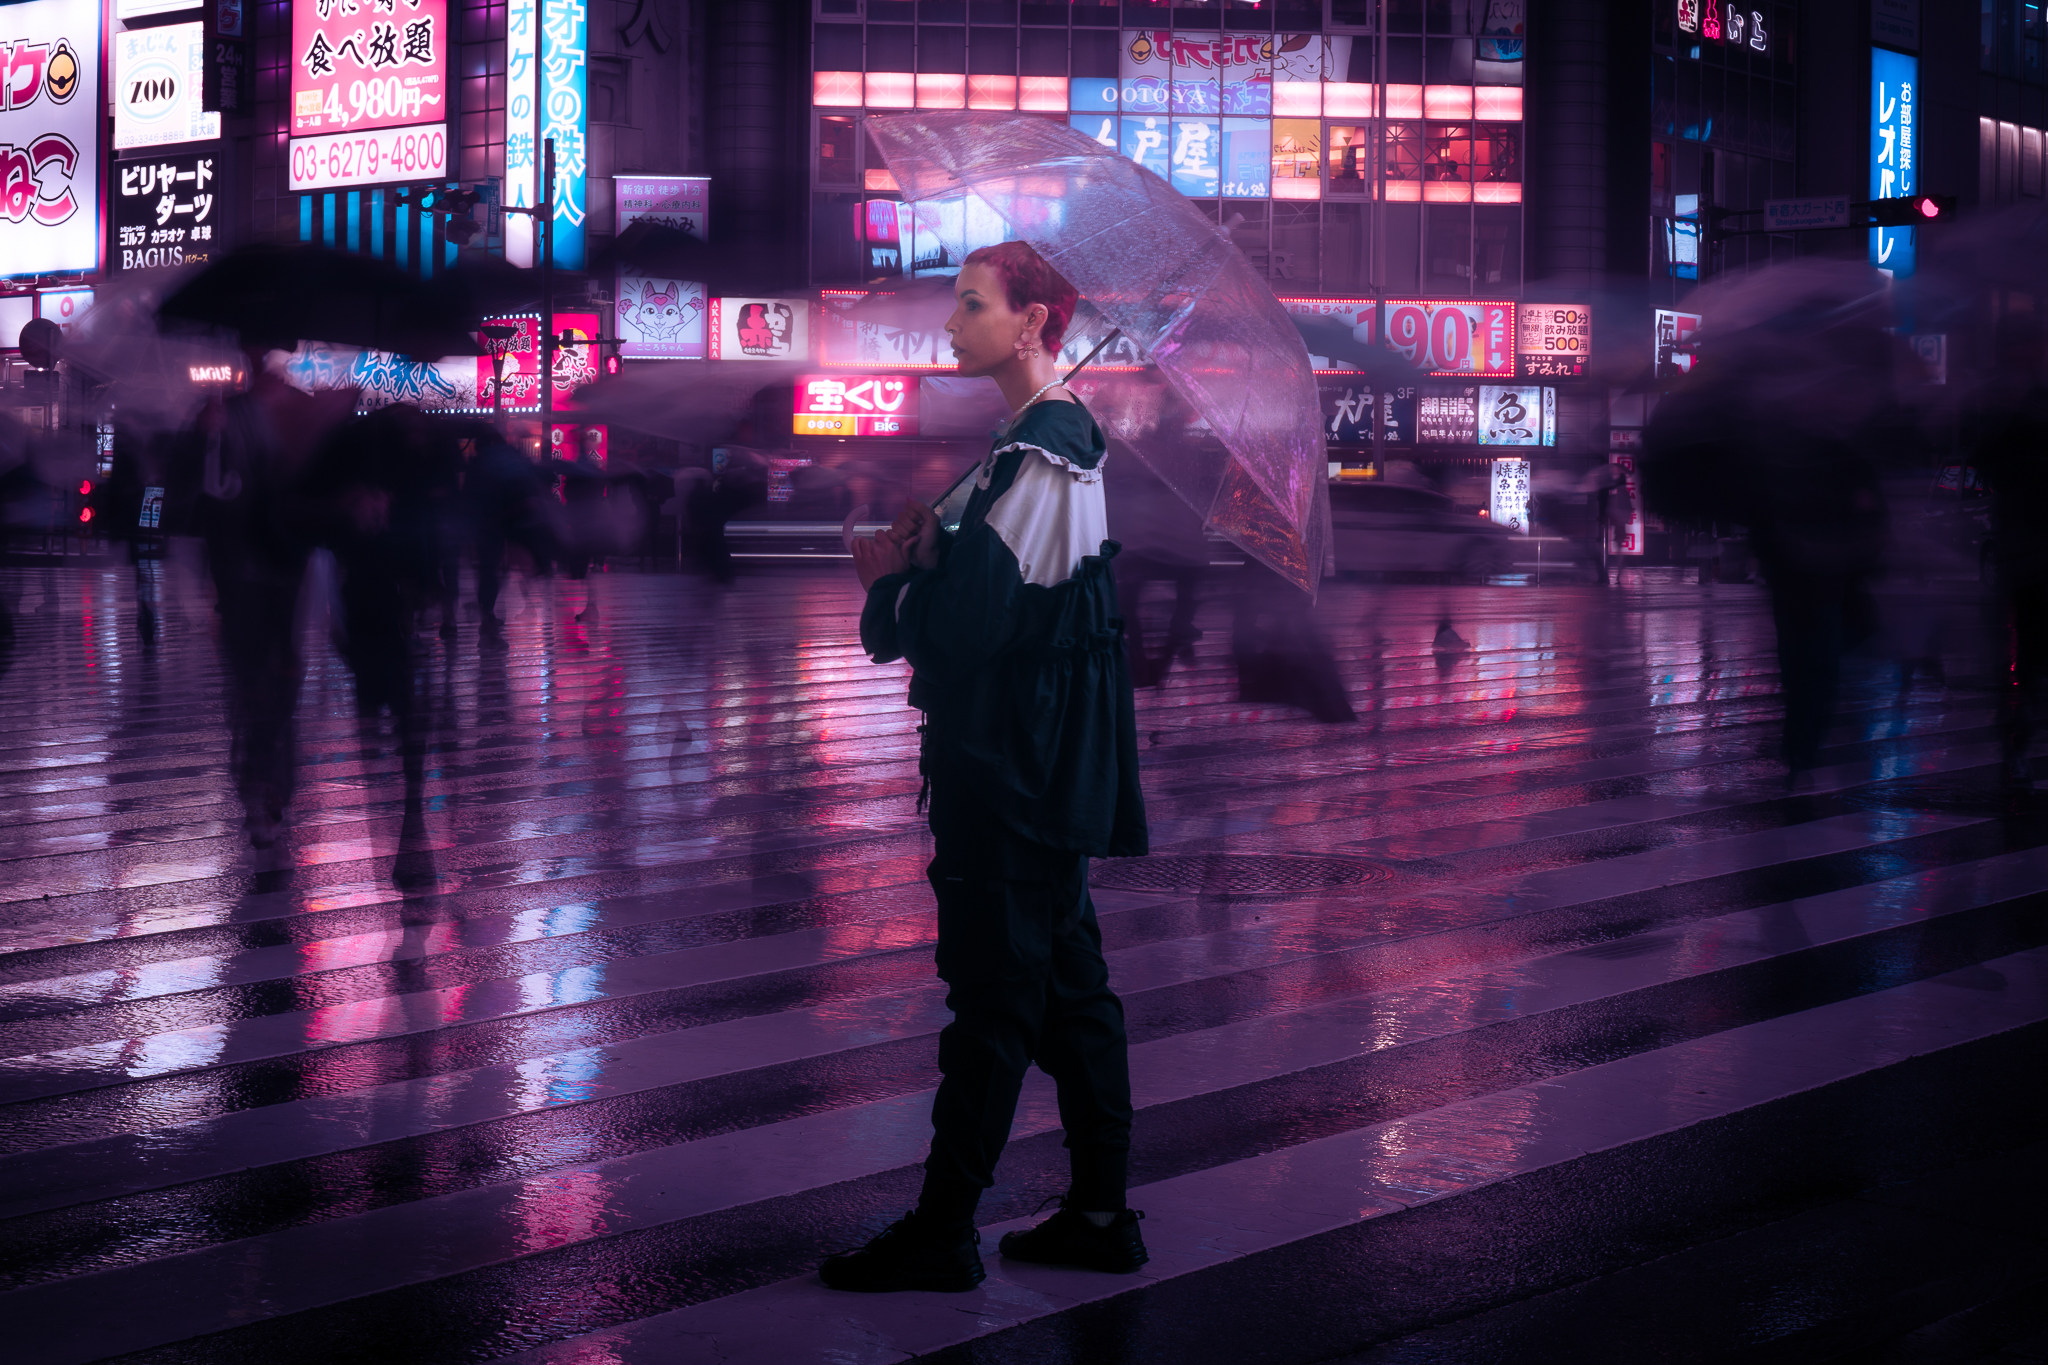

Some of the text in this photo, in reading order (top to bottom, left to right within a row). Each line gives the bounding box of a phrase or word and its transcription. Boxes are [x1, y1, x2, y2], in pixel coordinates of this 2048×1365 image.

[216, 43, 242, 66] 24H
[305, 18, 433, 76] 食べ放題
[0, 42, 50, 110] ケ
[130, 77, 175, 104] ZOO
[1102, 87, 1206, 105] OOTOYA
[1900, 82, 1911, 199] お部屋探し
[293, 131, 444, 182] 03-6279-4800
[121, 158, 213, 196] ビリヤード
[621, 184, 655, 196] 新宿駅
[156, 193, 213, 226] ダーツ
[1769, 201, 1845, 217] 新宿大ガード西
[120, 225, 212, 246] ゴルフ カラオケ 卓球
[122, 246, 209, 270] BAGUS バグース
[711, 300, 719, 358] AKAKARA
[1490, 309, 1504, 350] 2F
[1544, 325, 1588, 336] 飲み放題
[636, 344, 684, 353] こころちゃん
[1544, 337, 1588, 352] 500円
[190, 366, 231, 381] BAGUS
[1525, 361, 1572, 376] すみれ
[807, 379, 905, 412] 宝くじ
[1397, 387, 1415, 400] 3F
[807, 419, 842, 429] toto
[874, 417, 900, 432] BIG
